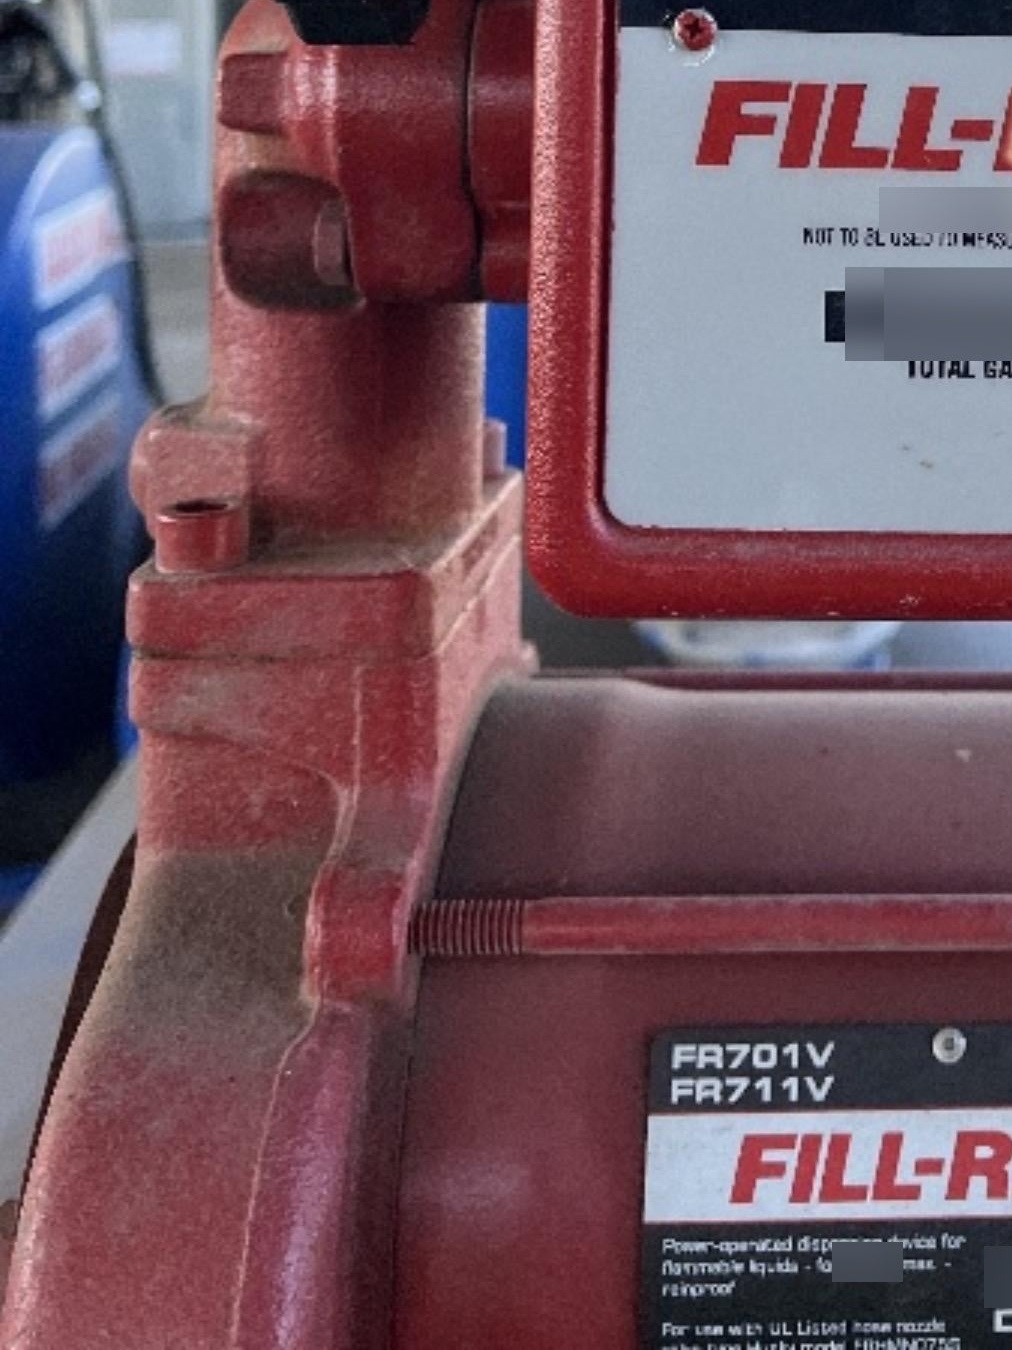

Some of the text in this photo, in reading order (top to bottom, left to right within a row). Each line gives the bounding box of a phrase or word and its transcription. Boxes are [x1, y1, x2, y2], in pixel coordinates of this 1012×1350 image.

[907, 360, 976, 379] TOTAL
[671, 1043, 835, 1071] FR701V
[670, 1075, 835, 1105] FR711V
